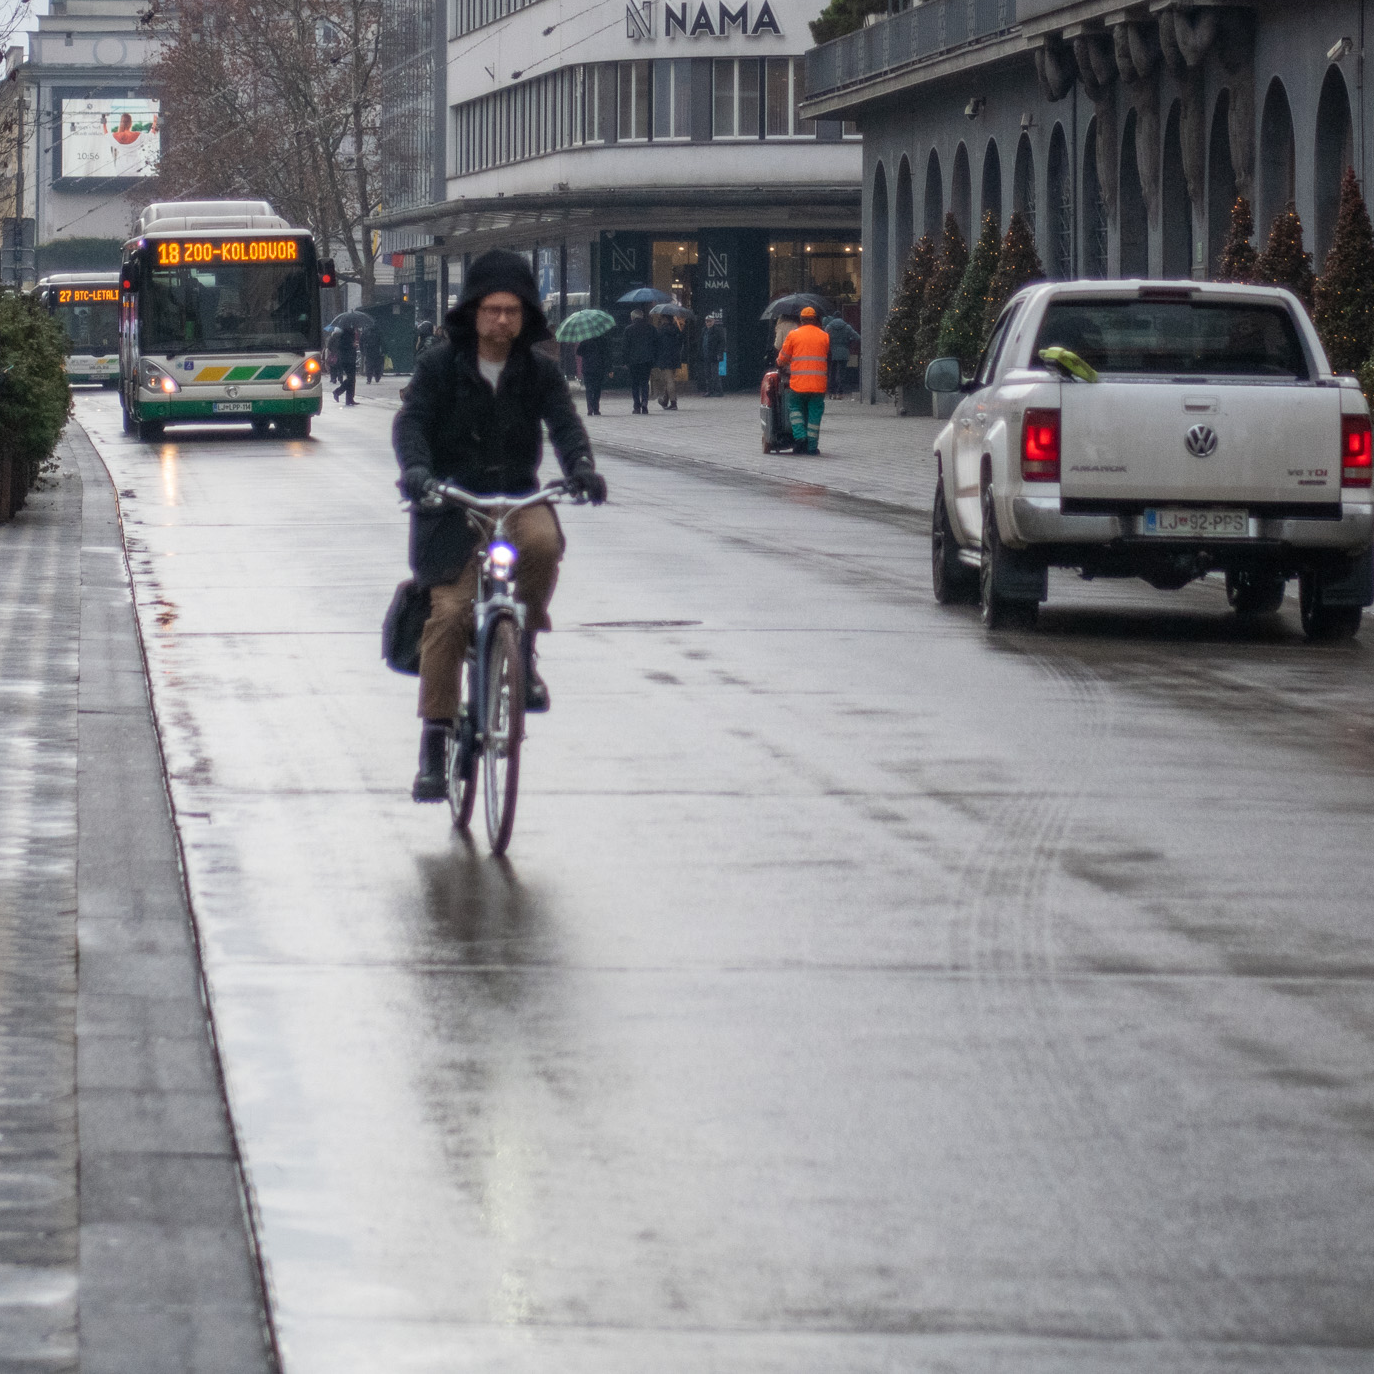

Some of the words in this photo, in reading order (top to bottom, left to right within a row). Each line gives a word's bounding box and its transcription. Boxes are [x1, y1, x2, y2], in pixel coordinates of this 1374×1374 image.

[77, 152, 100, 161] 10:56
[157, 242, 180, 265] 18
[183, 240, 297, 262] ZOO-KOLODVOR
[705, 280, 730, 289] NAMA
[59, 290, 71, 303] 27
[1069, 465, 1127, 473] AMAROK
[1307, 468, 1328, 476] TDI
